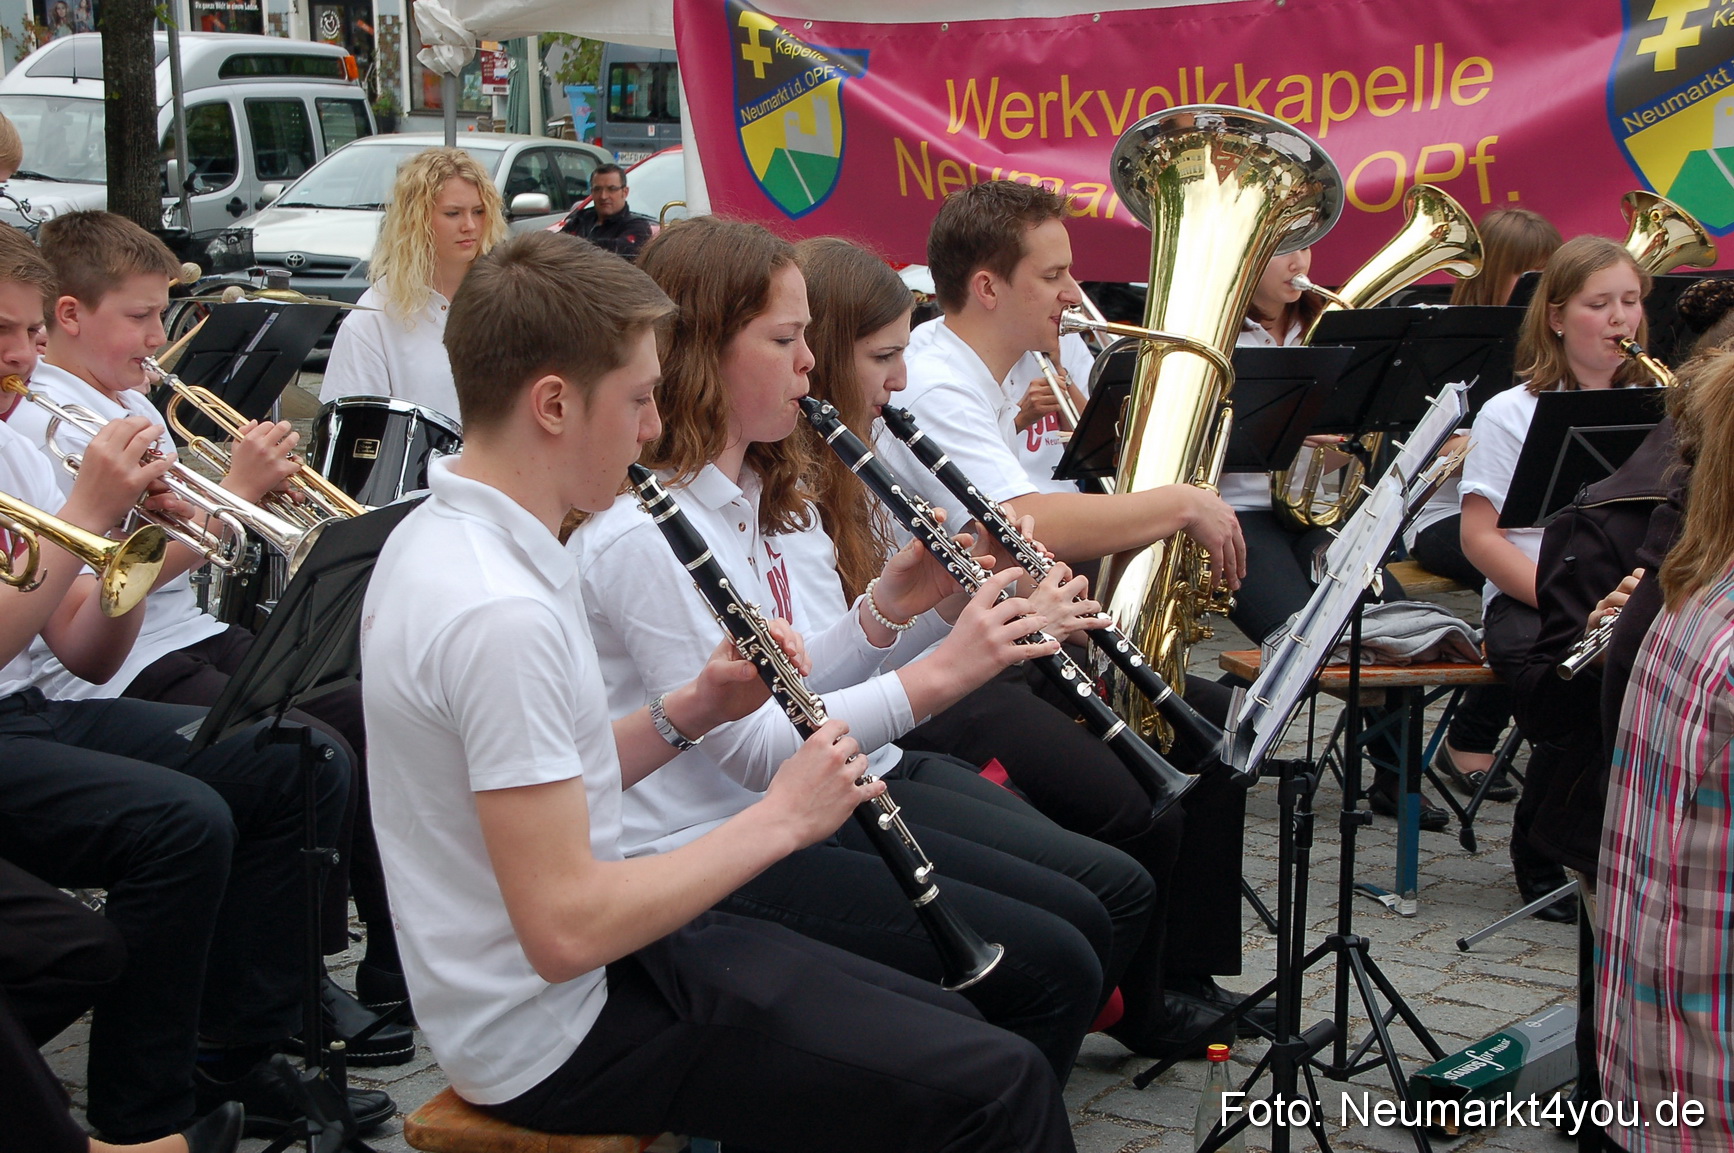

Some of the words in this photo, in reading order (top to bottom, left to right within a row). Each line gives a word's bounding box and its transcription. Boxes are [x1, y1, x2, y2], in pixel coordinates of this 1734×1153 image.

[740, 87, 790, 124] Neumarkt
[1621, 67, 1732, 134] Neumarkt
[1346, 135, 1520, 213] OPf.
[1444, 1060, 1487, 1081] STANDS
